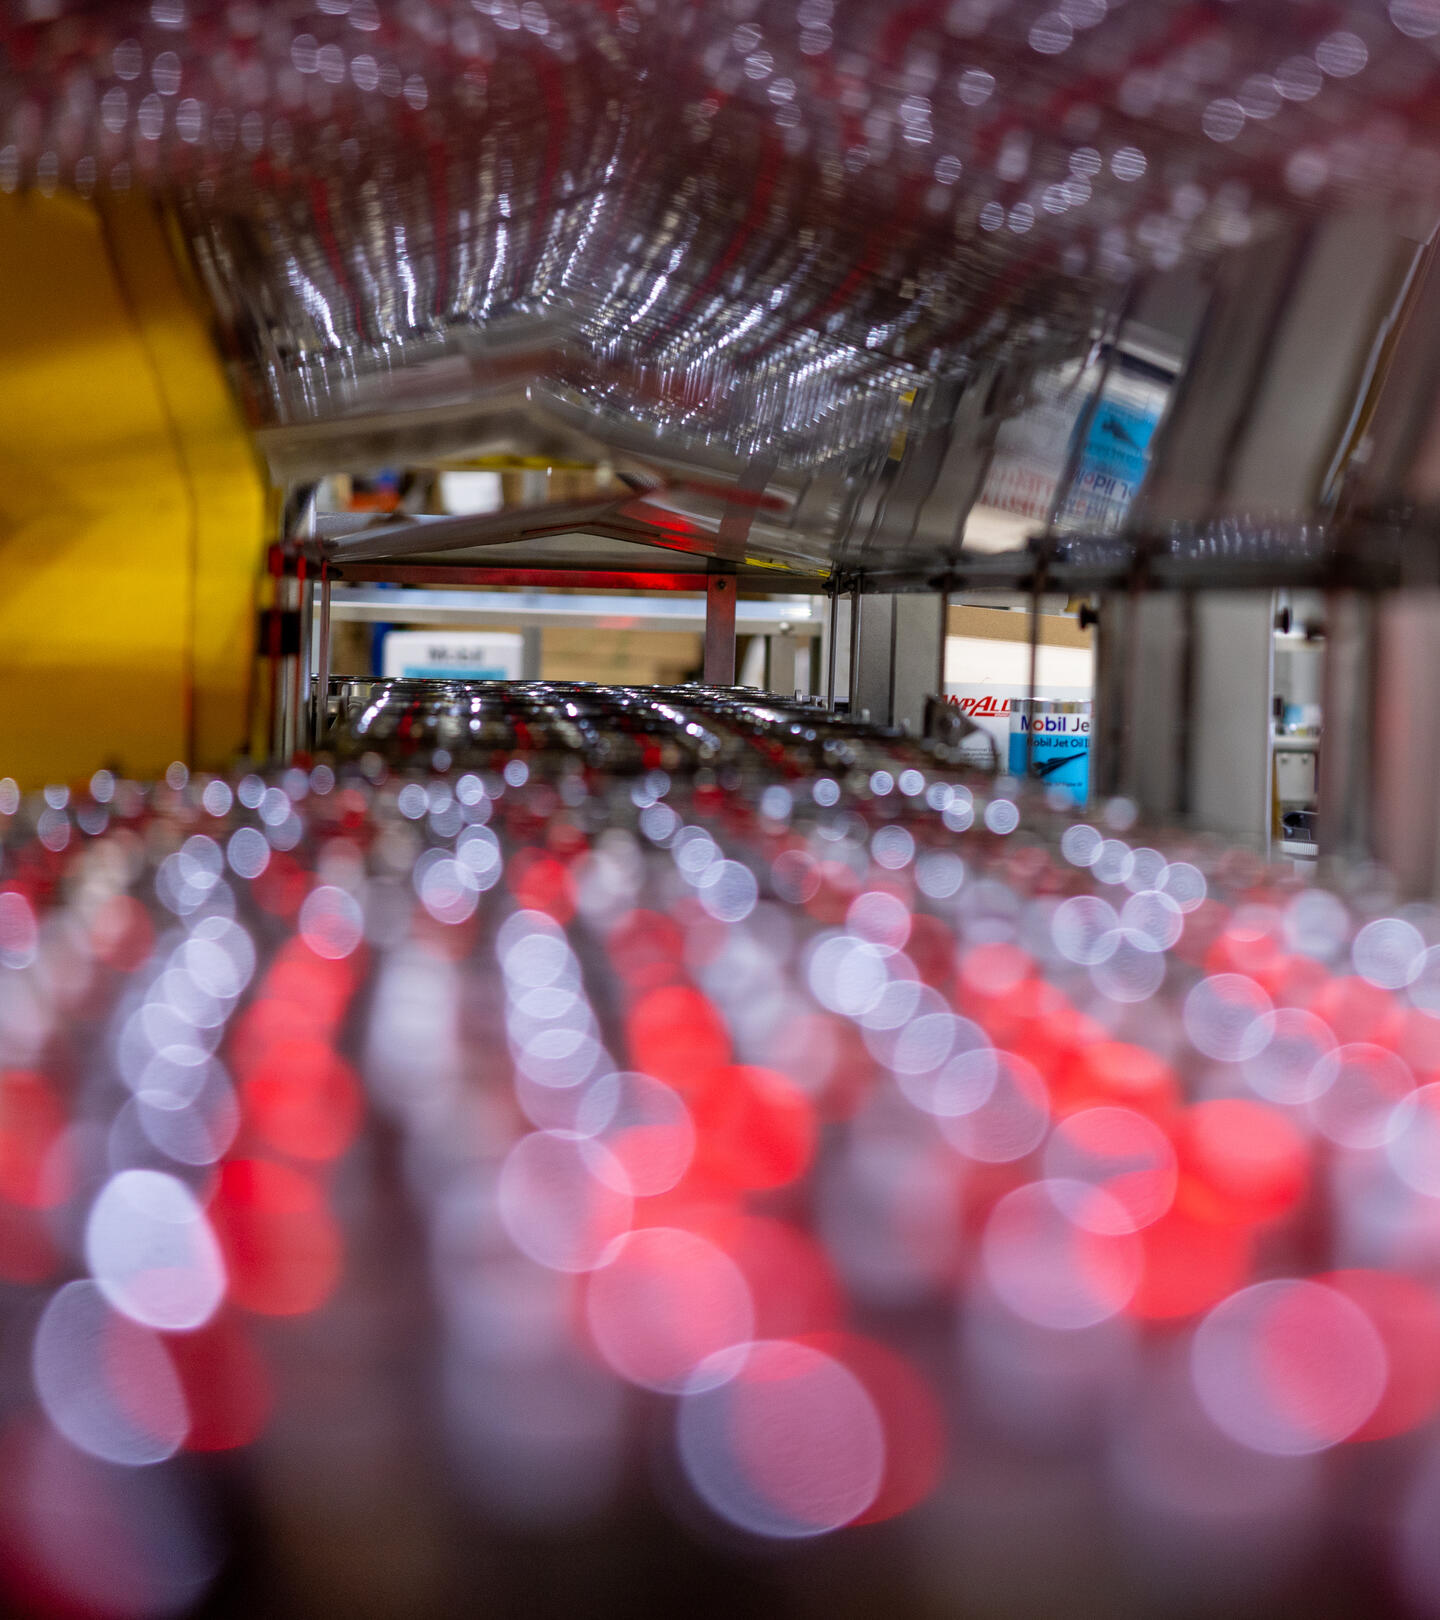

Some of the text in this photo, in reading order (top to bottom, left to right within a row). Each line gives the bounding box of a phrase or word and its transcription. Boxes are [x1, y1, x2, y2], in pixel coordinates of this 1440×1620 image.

[1021, 714, 1067, 732] Mobil
[1053, 738, 1069, 748] Jet
[1070, 738, 1084, 748] Oil
